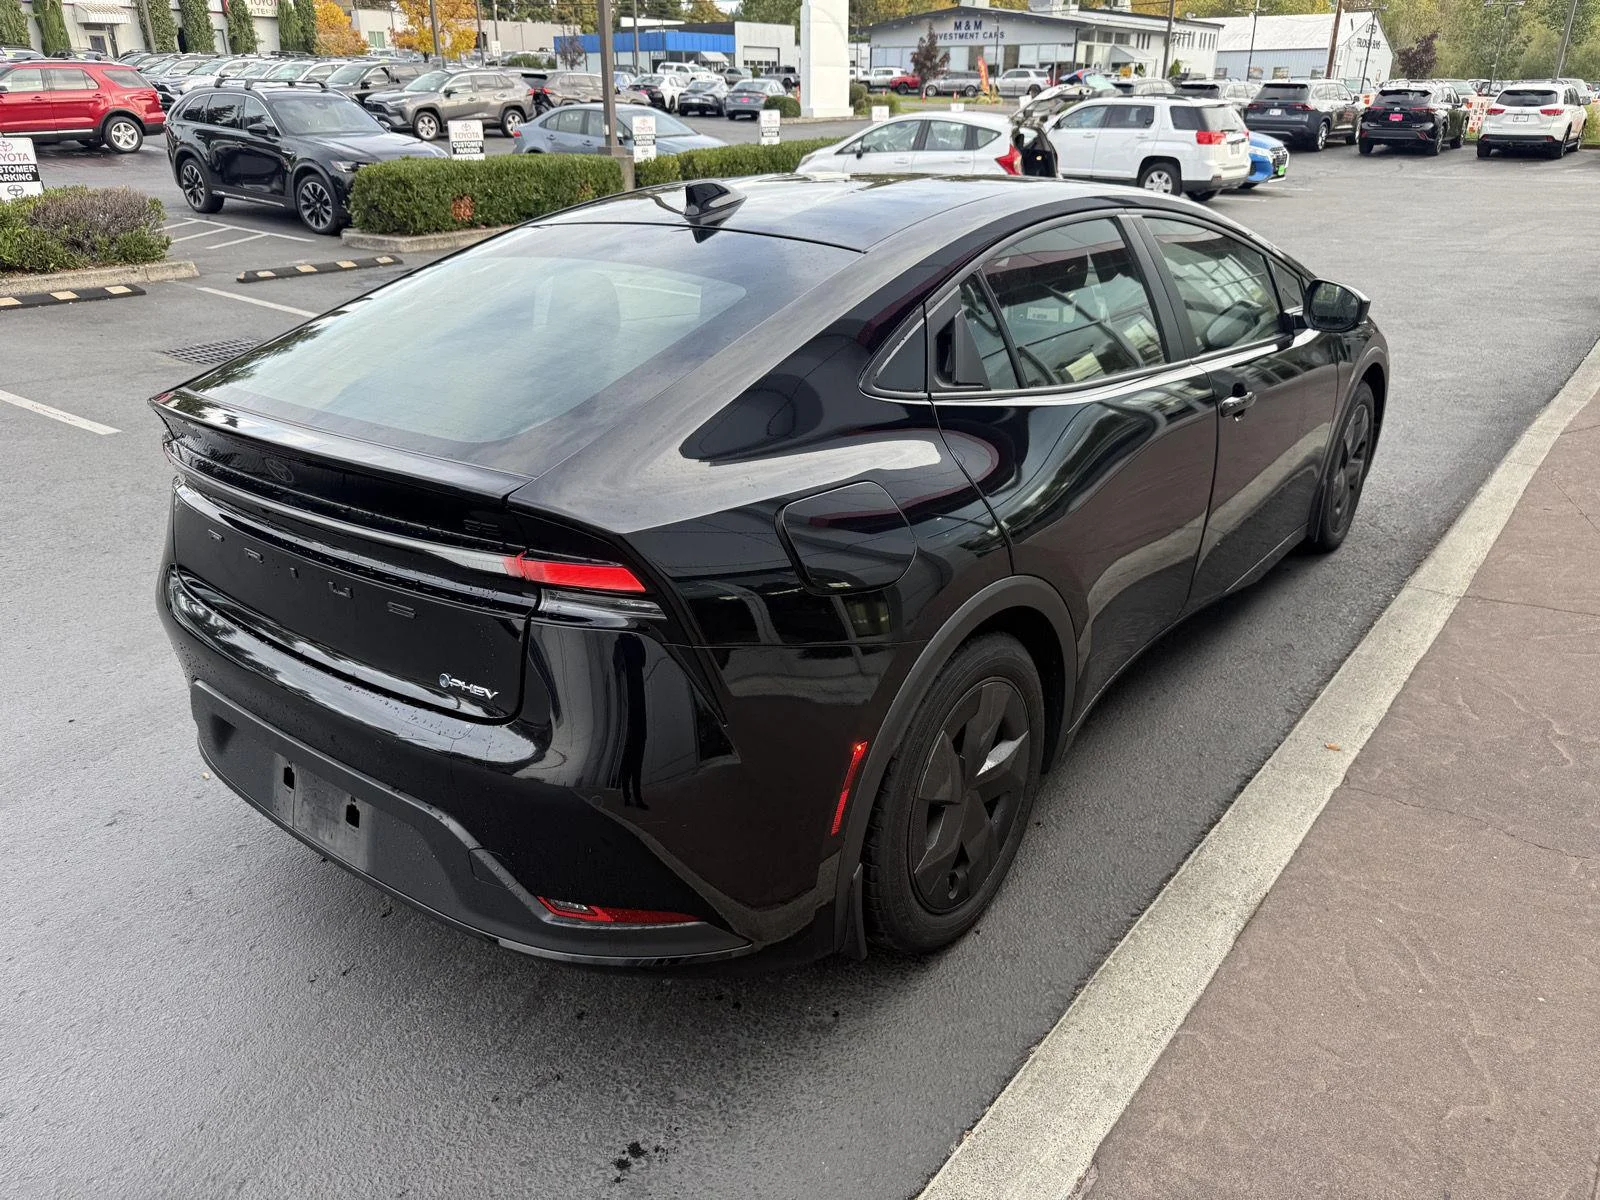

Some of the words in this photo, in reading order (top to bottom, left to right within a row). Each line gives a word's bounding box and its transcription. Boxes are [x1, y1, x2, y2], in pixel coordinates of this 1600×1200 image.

[954, 21, 962, 31] M
[964, 20, 971, 31] &
[974, 20, 982, 31] M
[935, 32, 979, 41] NVESTMENT
[454, 131, 480, 139] TOYOTA
[450, 678, 499, 700] PHEV
